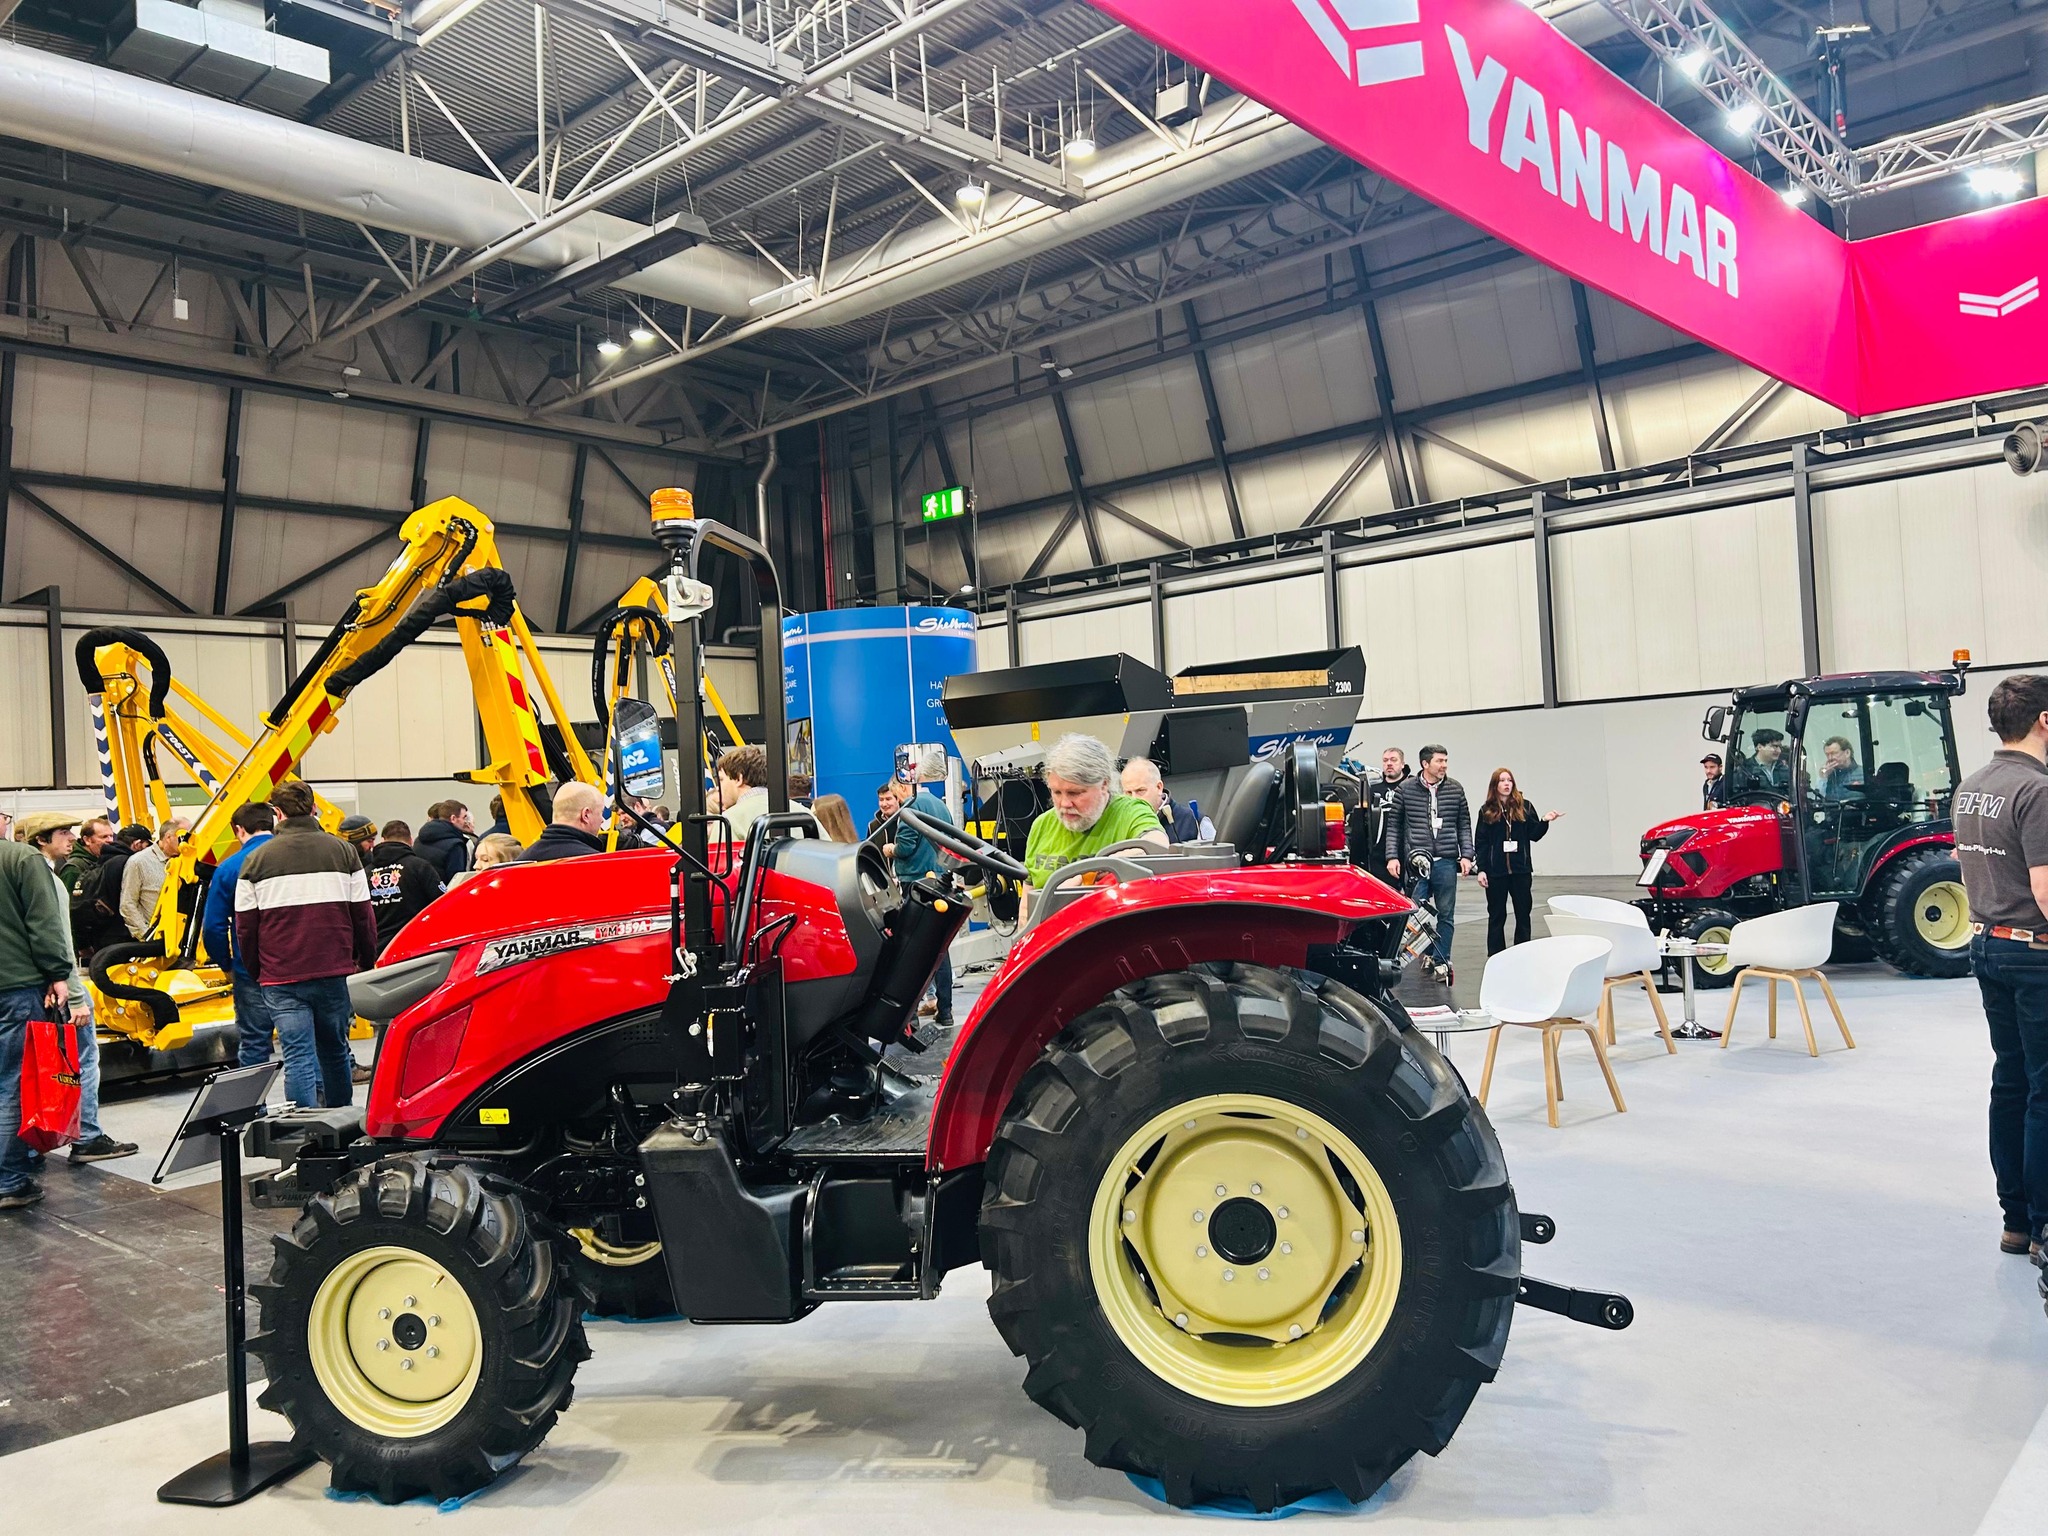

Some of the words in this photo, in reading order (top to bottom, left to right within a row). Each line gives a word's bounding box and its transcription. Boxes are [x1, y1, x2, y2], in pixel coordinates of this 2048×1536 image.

[1444, 24, 1738, 299] YANMAR
[930, 681, 943, 690] HA
[1335, 681, 1351, 693] 2300
[493, 930, 580, 960] YANMAR
[600, 920, 648, 937] YM359A
